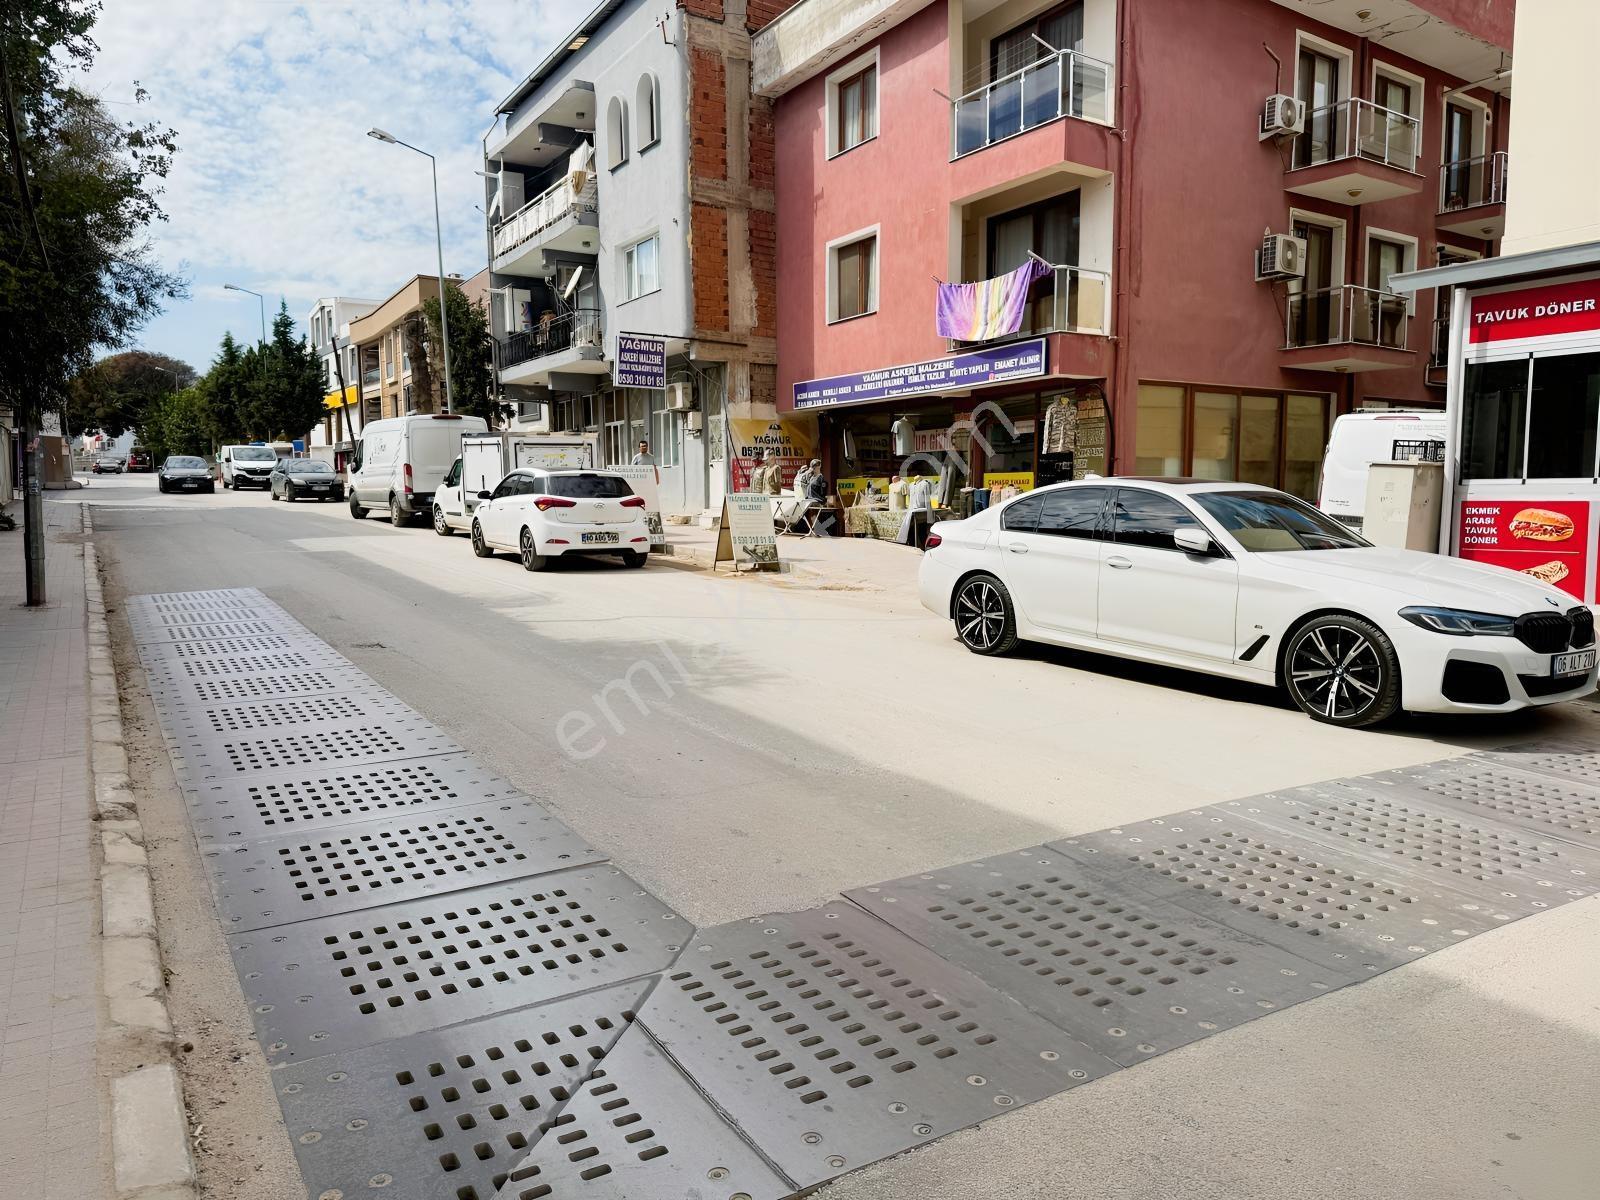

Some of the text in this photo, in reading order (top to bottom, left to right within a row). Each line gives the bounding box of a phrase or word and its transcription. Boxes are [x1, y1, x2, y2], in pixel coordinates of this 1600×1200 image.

[1475, 298, 1596, 324] TAVUK DÖNER
[620, 339, 664, 352] YAĞMUR
[863, 361, 954, 382] YAĞMUR ASKERİ MALZEME
[753, 433, 792, 444] YAĞMUR
[1466, 507, 1500, 515] EKMEK
[1464, 535, 1498, 544] DÖNER
